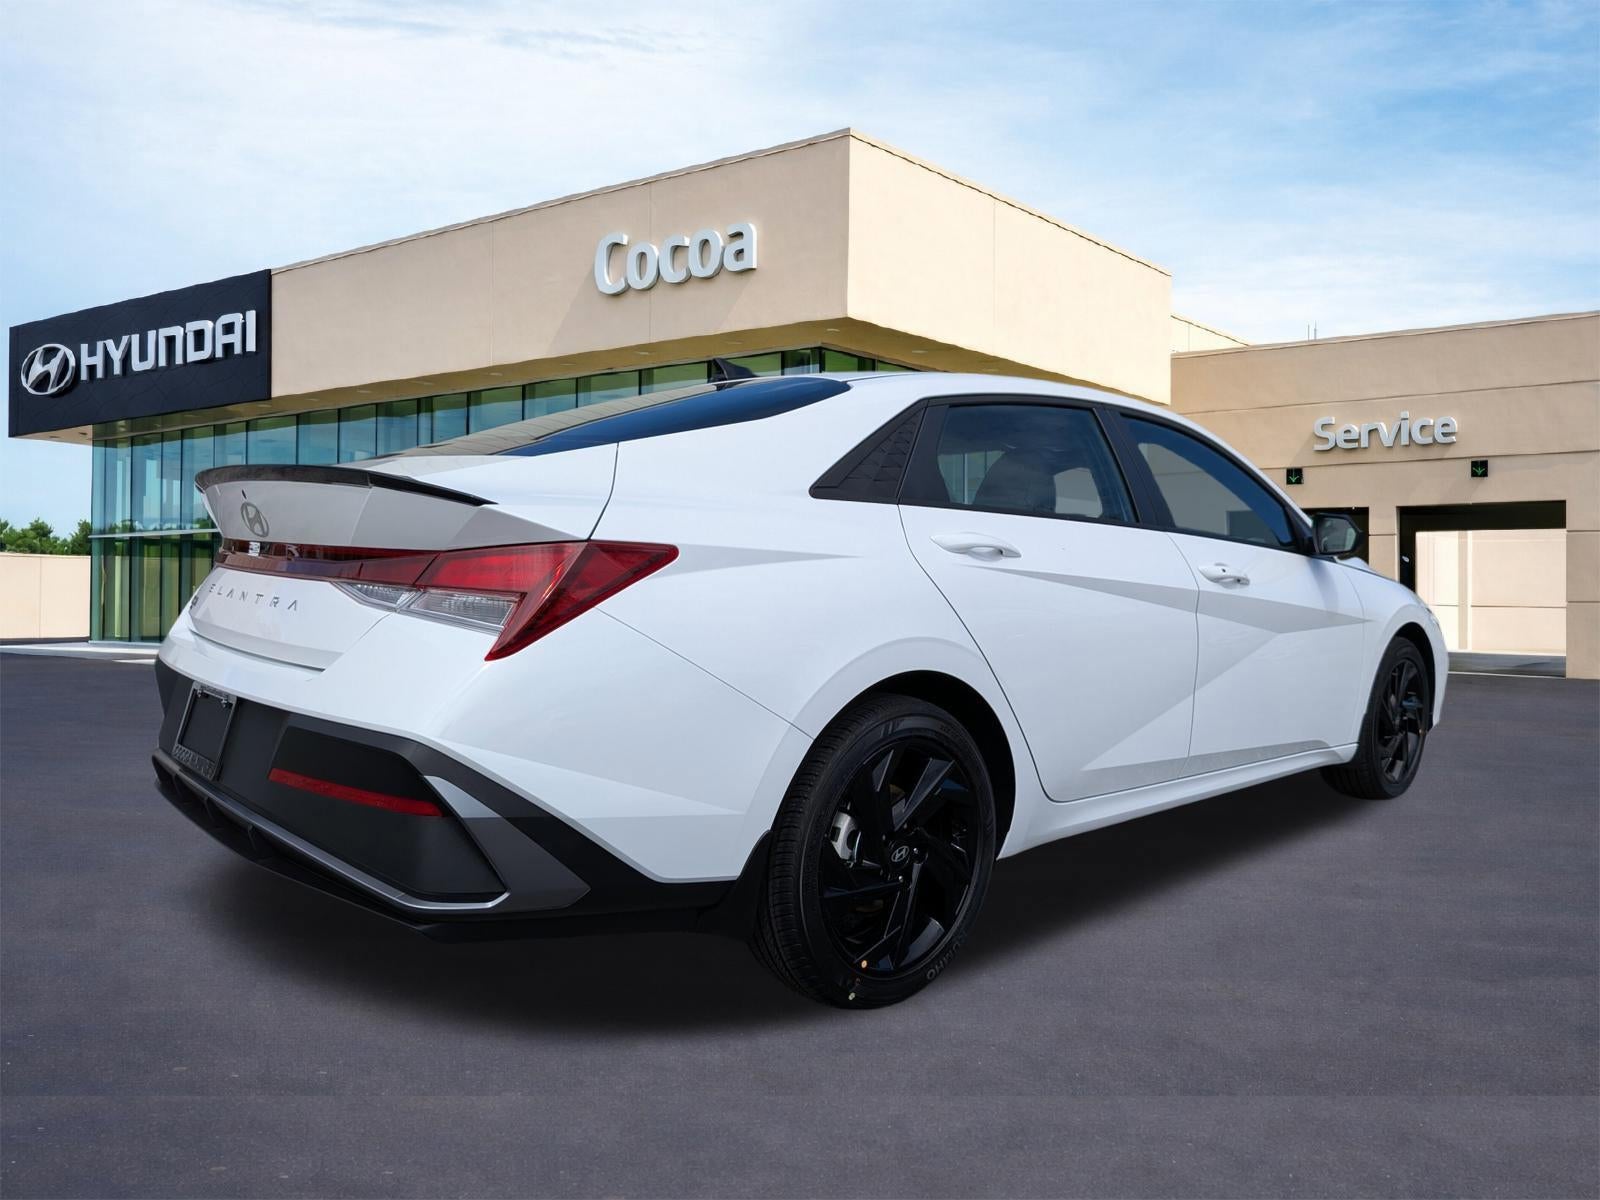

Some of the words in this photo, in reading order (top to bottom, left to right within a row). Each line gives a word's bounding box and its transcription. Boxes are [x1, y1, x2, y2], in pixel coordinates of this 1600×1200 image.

[594, 223, 758, 295] Cocoa
[80, 310, 257, 381] HYUNDAI
[1312, 411, 1458, 451] Service
[208, 583, 299, 611] ELANTRA
